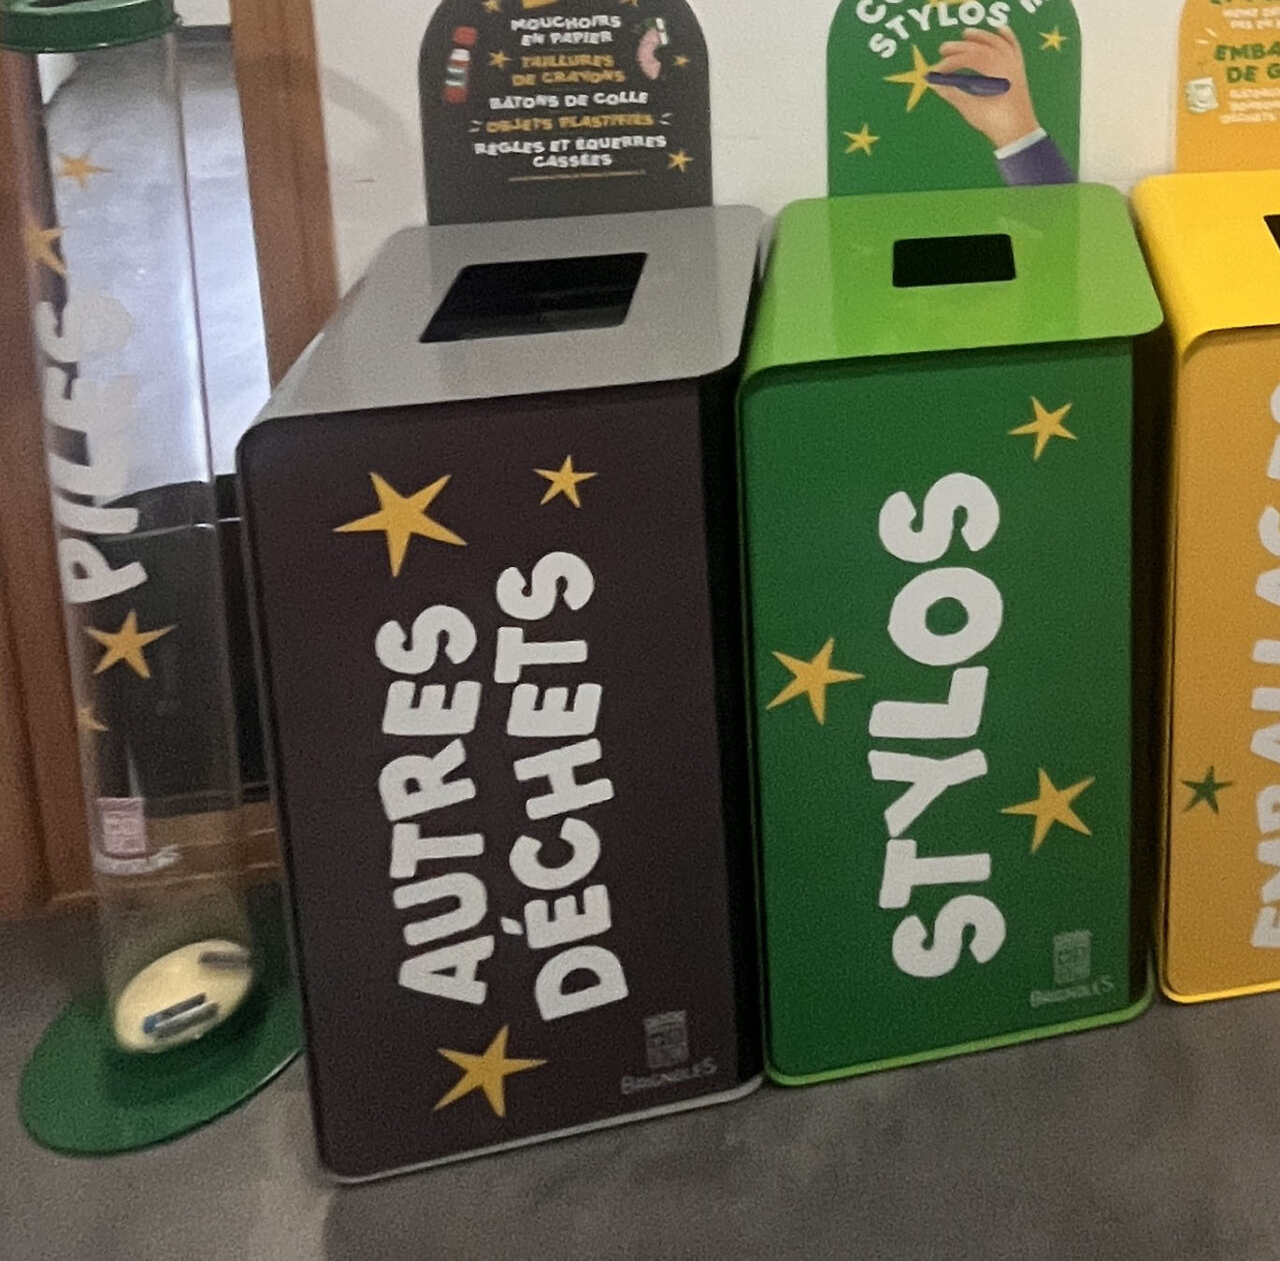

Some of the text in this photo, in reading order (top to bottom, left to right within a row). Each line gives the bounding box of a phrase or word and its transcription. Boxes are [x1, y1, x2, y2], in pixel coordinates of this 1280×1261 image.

[511, 15, 622, 31] MOUCHOIRS
[868, 0, 1011, 58] STYLOS
[521, 30, 614, 46] EN PAPIER
[512, 74, 536, 87] DE
[1226, 65, 1258, 83] DE
[564, 94, 589, 107] DE
[593, 91, 648, 105] COLLE
[550, 139, 571, 153] ET
[868, 472, 1006, 978] STYLOS
[494, 550, 630, 1021] DÉCHETS
[375, 604, 495, 1005] AUTRES
